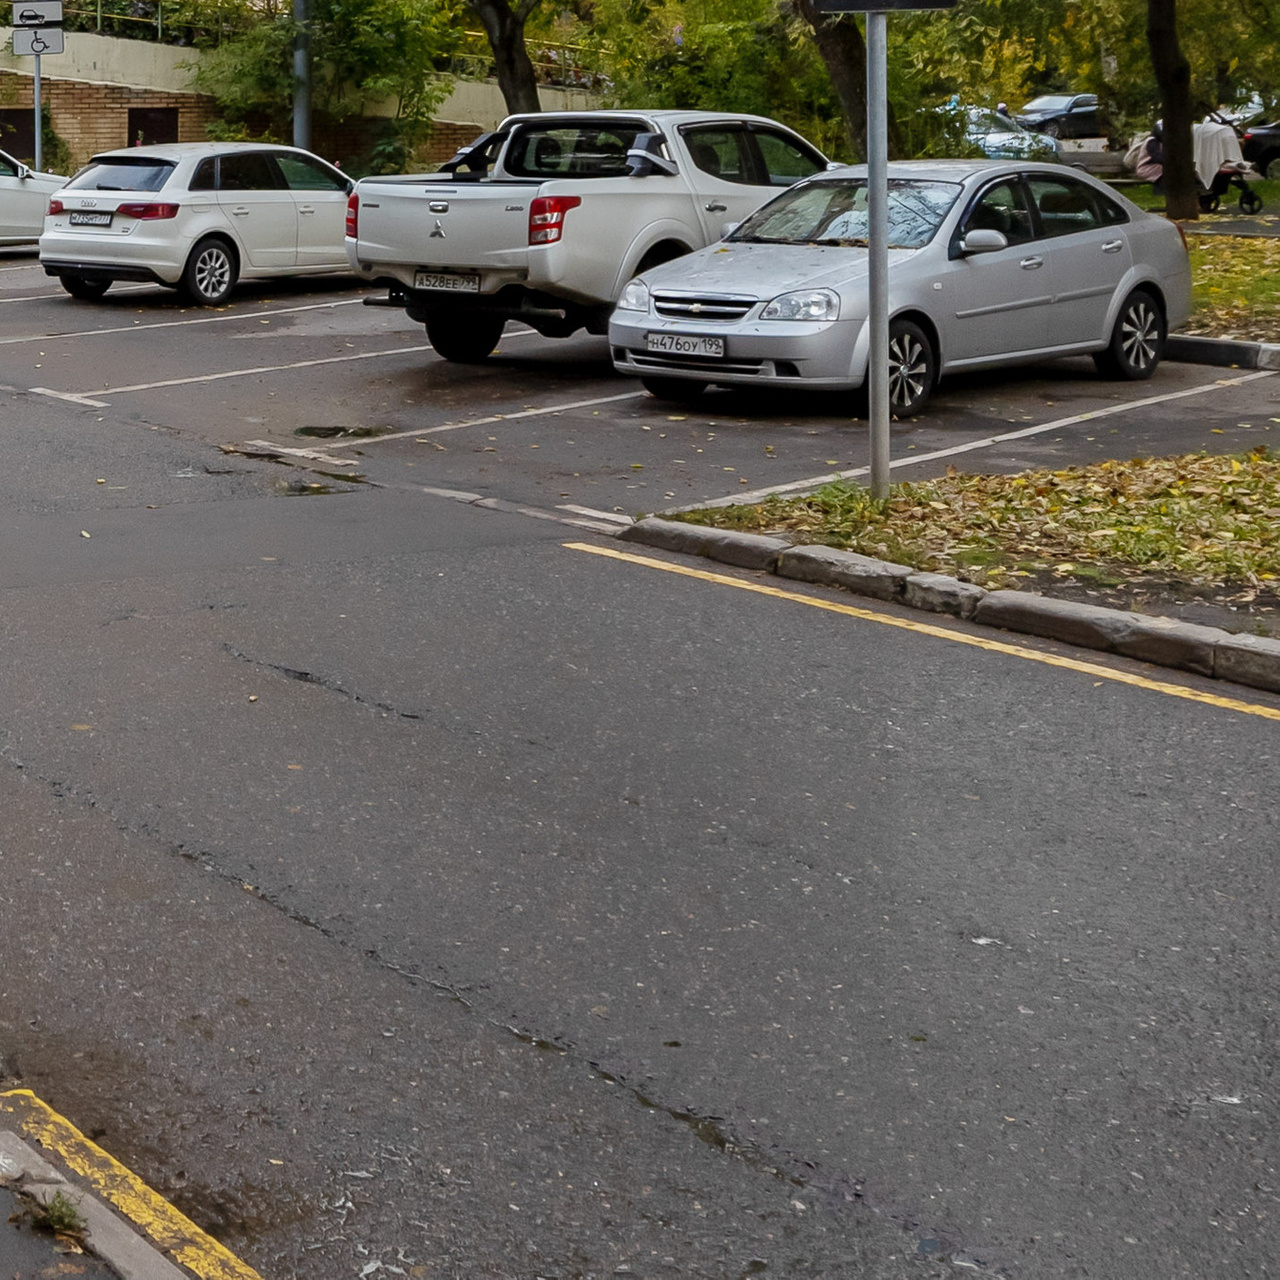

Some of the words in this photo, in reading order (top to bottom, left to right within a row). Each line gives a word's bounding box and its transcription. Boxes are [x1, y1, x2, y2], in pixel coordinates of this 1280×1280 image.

[418, 274, 458, 289] А528ЕЕ
[651, 336, 698, 352] Н476ОУ
[701, 338, 720, 351] 199
